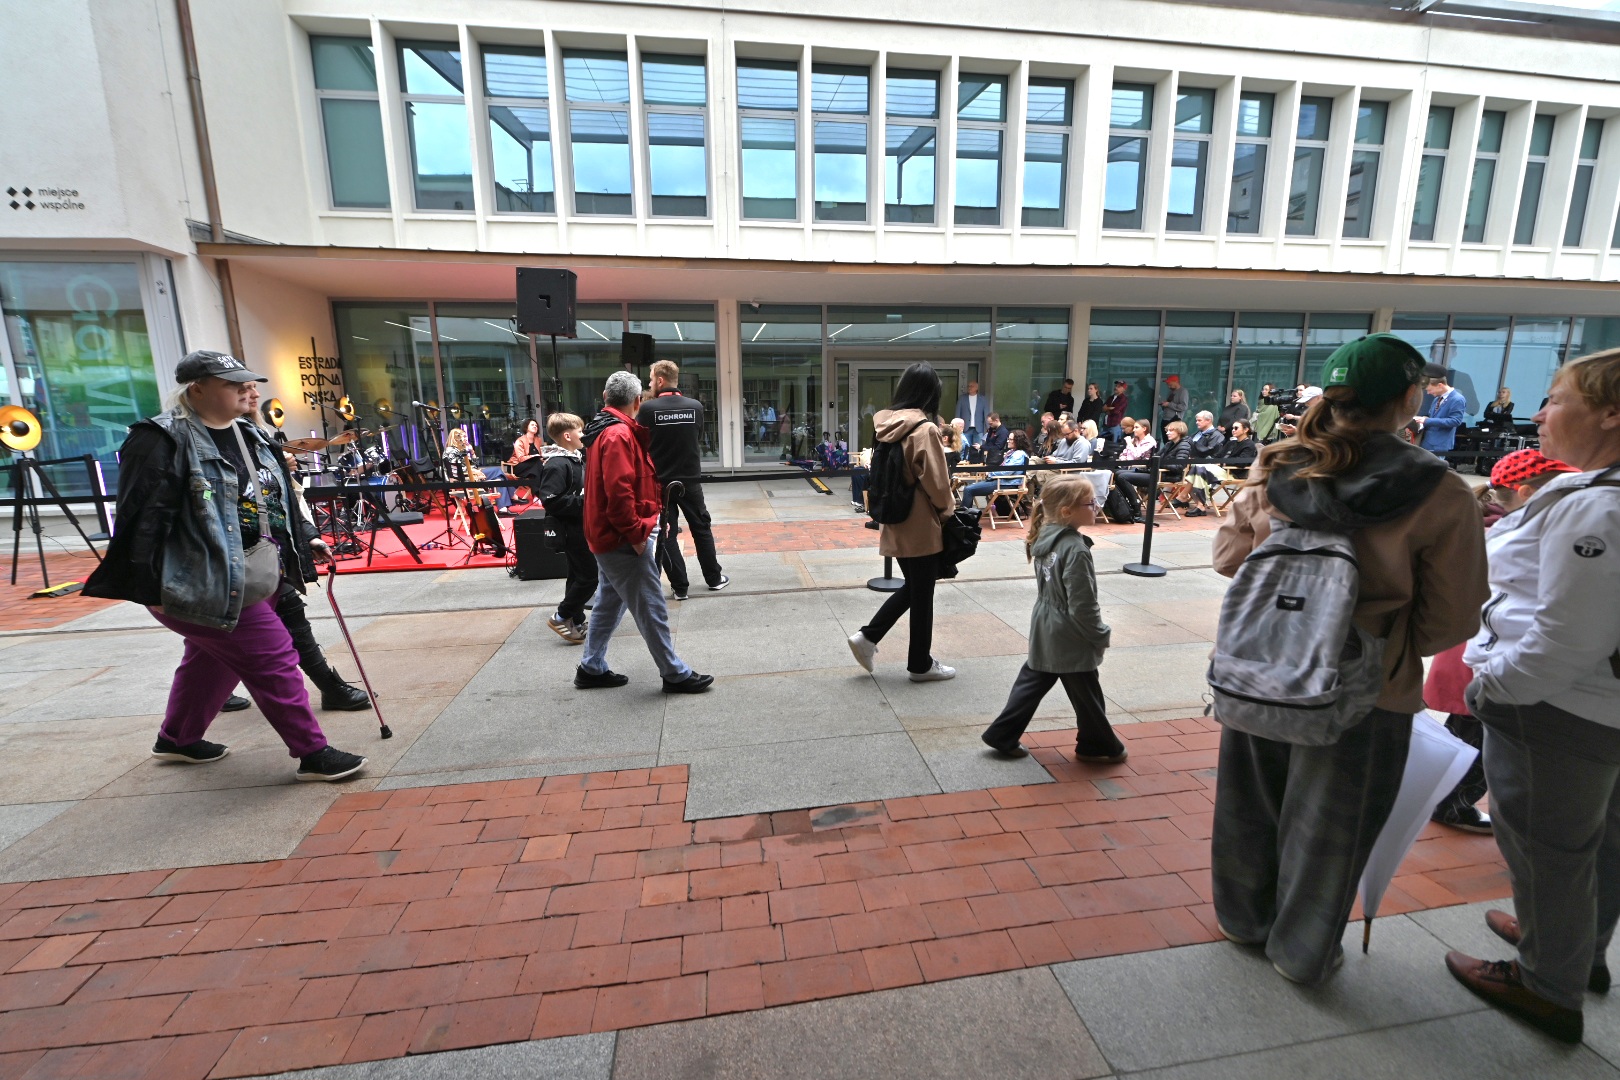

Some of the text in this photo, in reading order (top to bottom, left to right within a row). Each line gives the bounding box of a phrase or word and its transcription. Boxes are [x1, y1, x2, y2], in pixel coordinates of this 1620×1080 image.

[38, 187, 79, 199] miejsce
[40, 198, 85, 212] wspólne
[298, 356, 342, 370] ESTRADA
[658, 413, 693, 421] OCHRONA
